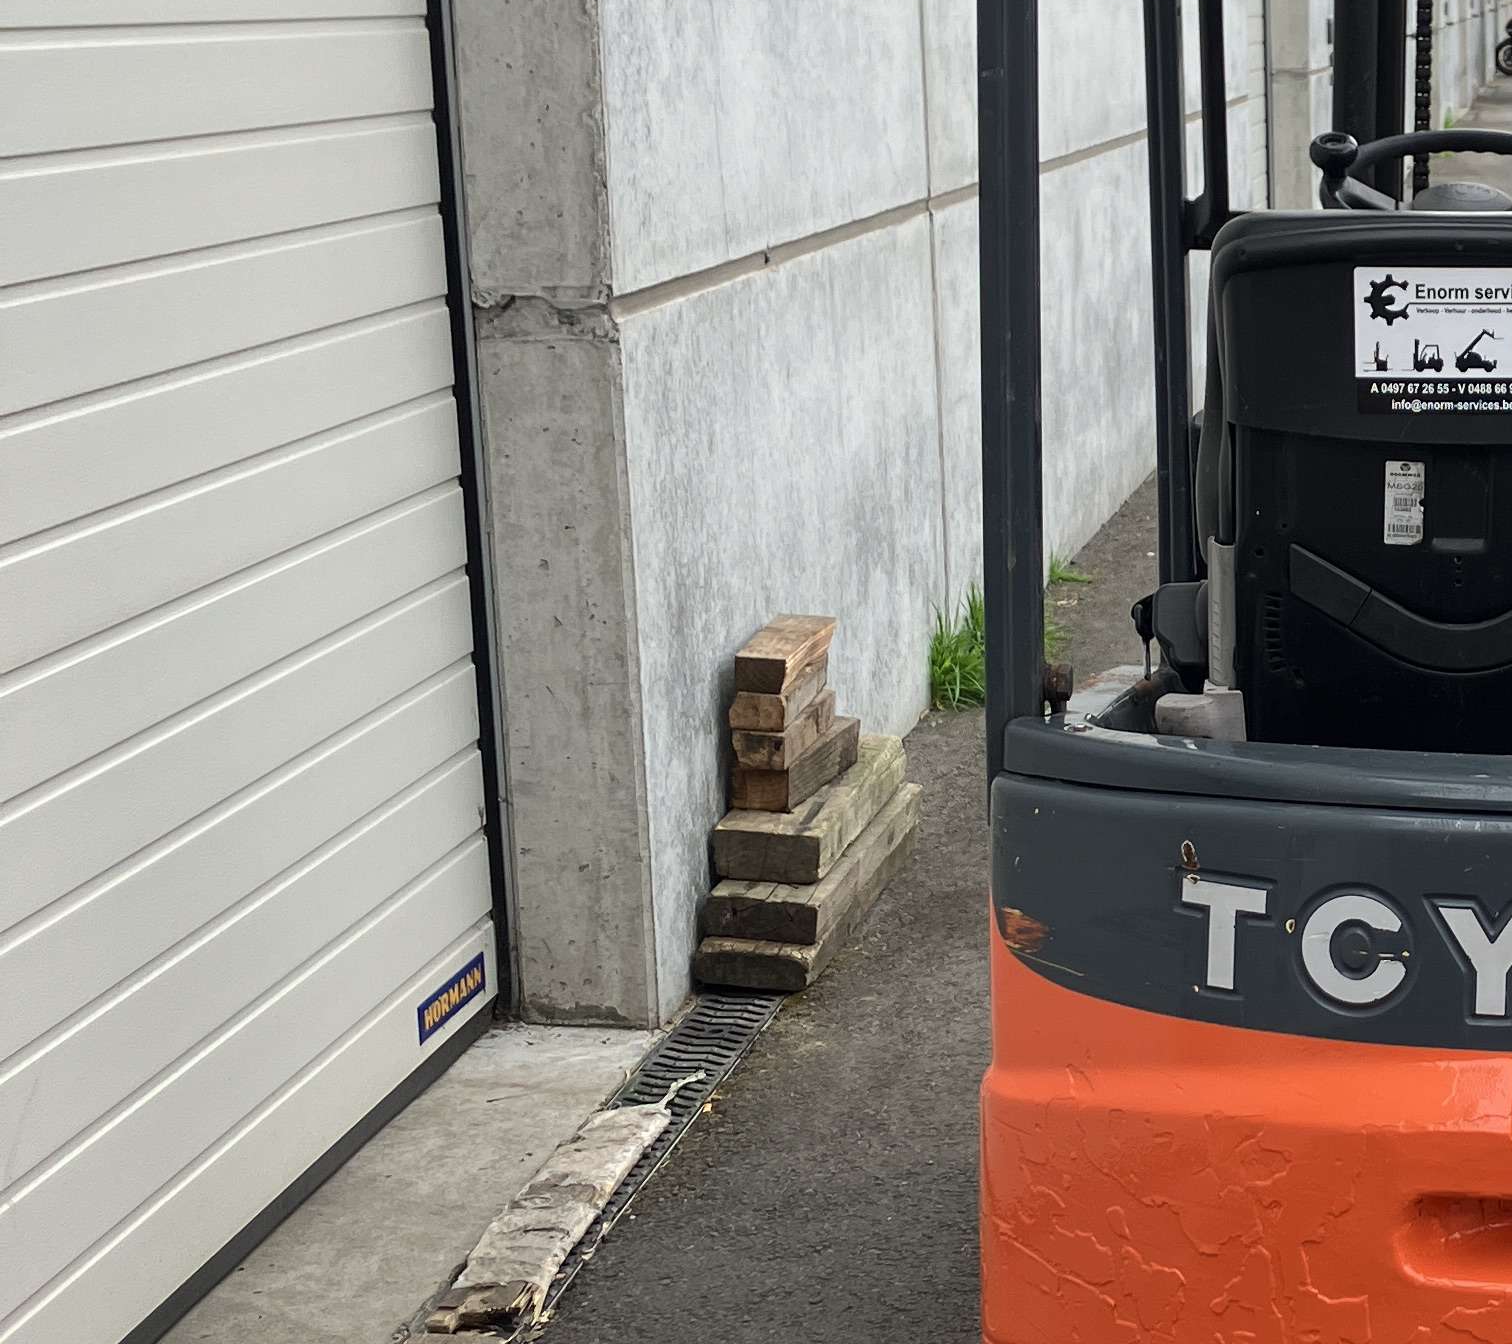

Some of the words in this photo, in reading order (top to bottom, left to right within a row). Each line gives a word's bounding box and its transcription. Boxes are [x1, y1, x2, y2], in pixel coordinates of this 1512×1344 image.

[1415, 284, 1469, 299] Enorm
[1370, 383, 1379, 394] A
[1381, 383, 1405, 394] 0497
[1407, 383, 1419, 394] 67
[1422, 383, 1435, 394] 26
[1437, 383, 1450, 394] 55
[1458, 383, 1466, 394] V
[1468, 383, 1492, 394] 0488
[1494, 383, 1507, 394] 66
